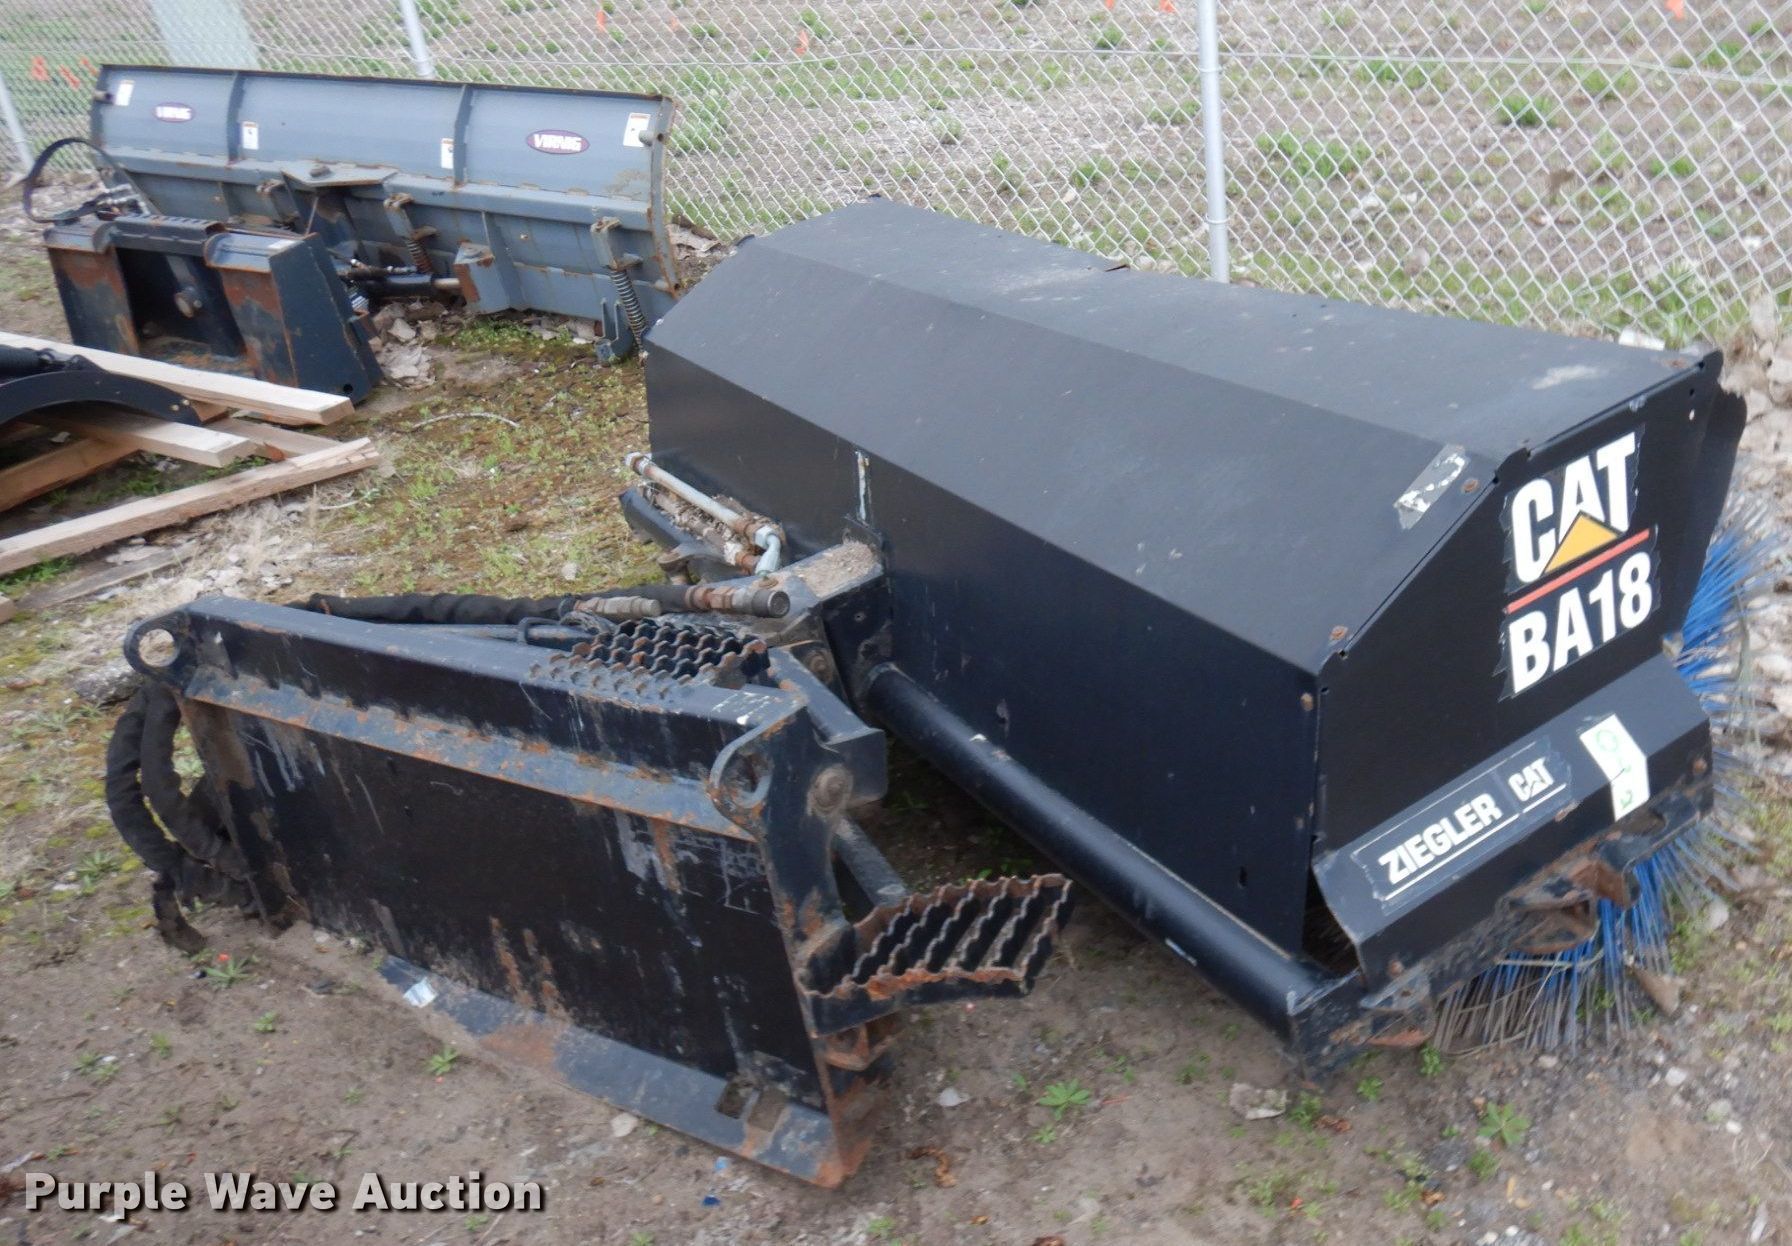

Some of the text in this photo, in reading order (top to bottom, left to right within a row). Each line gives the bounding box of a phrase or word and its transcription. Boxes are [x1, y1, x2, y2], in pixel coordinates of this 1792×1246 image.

[1511, 432, 1636, 584] CAT
[1508, 552, 1653, 694] BA18
[1378, 793, 1503, 885] ZIEGLER
[1508, 756, 1554, 802] CAT
